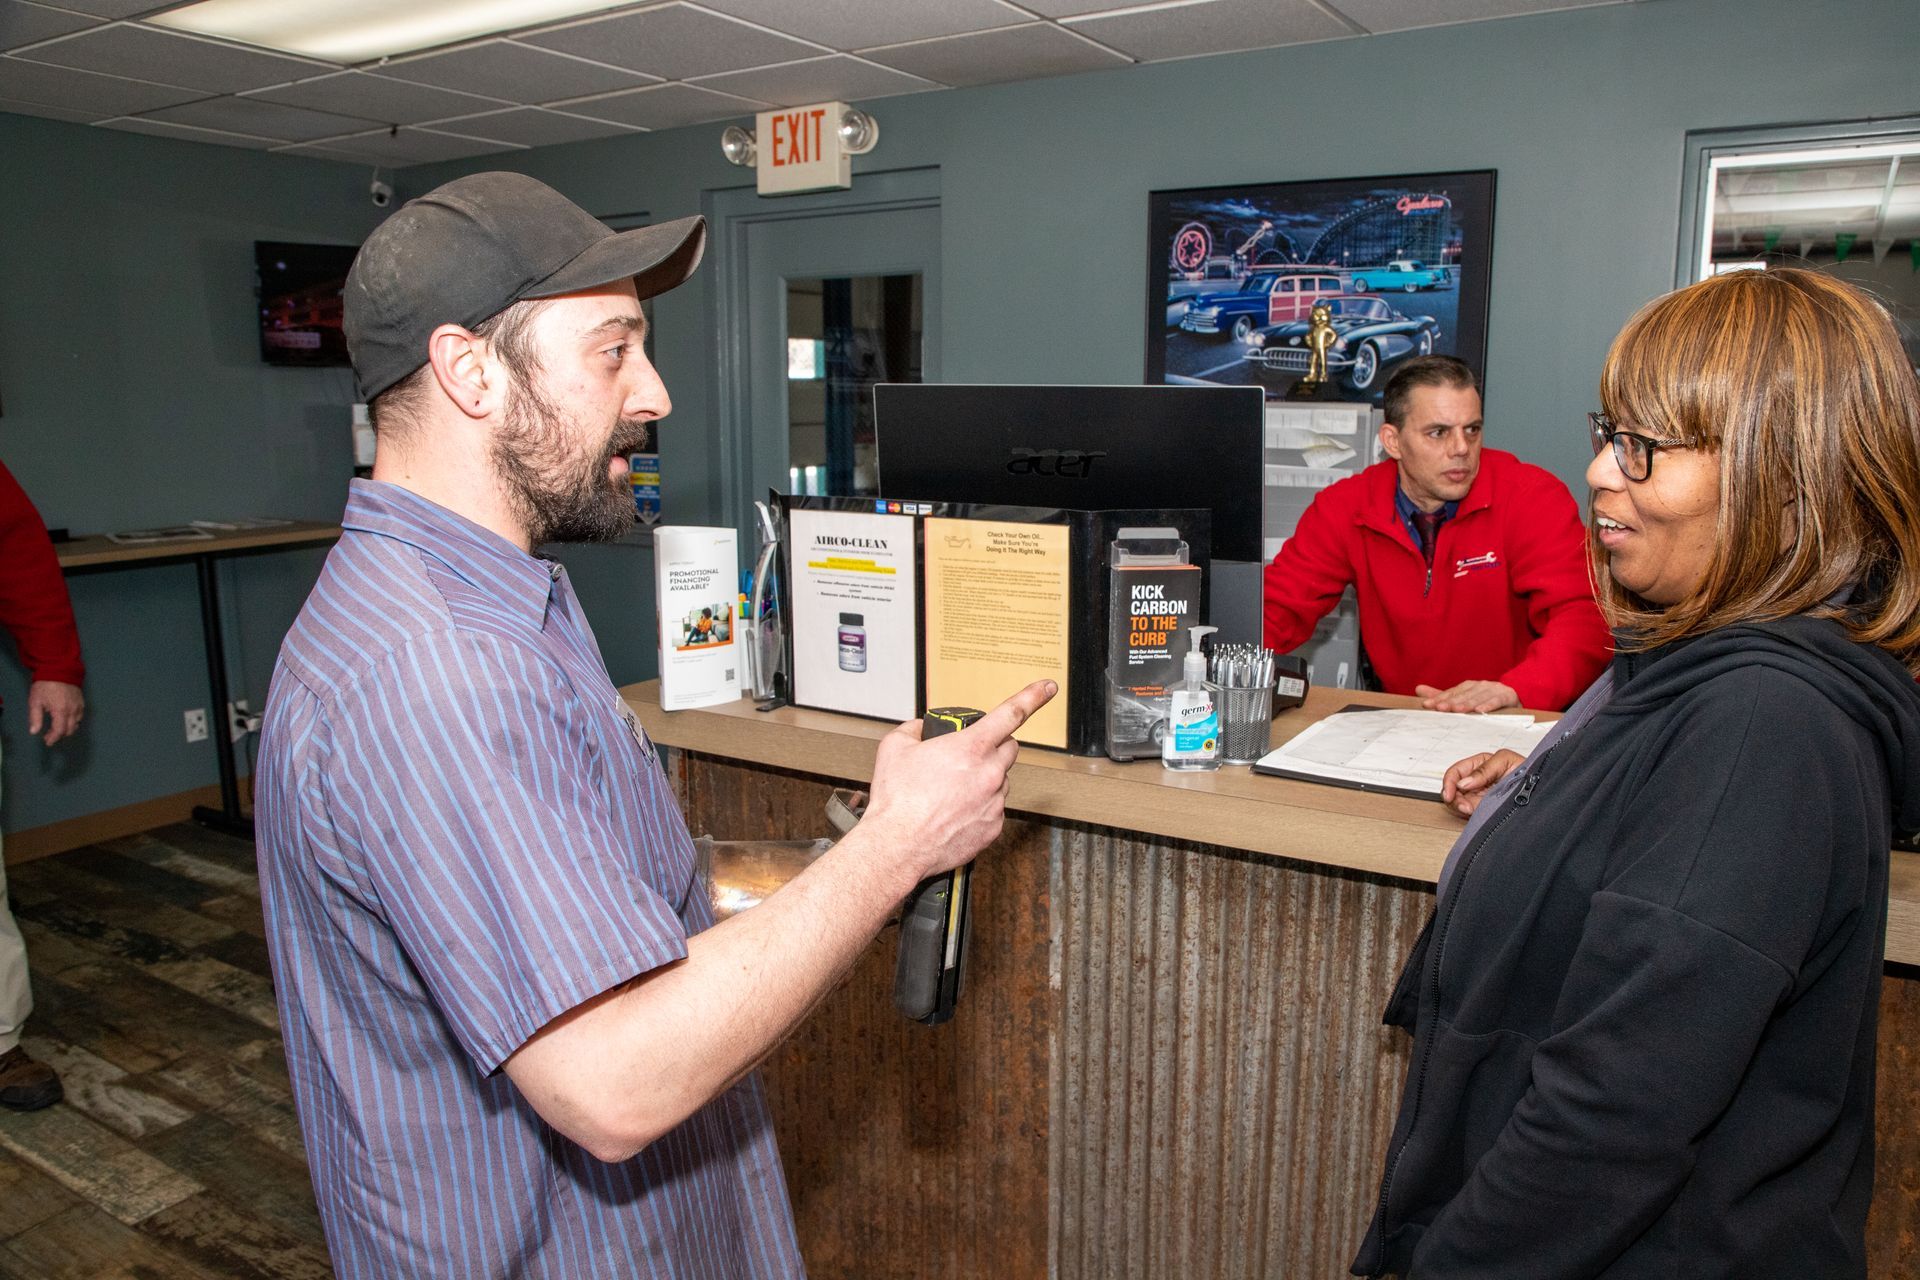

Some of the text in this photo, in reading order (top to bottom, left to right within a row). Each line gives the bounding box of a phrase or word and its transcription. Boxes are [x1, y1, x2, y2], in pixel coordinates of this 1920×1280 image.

[772, 109, 825, 166] EXIT
[1007, 448, 1107, 478] acer
[815, 535, 888, 549] AIRCO-CLEAN
[986, 546, 1001, 554] Doing
[670, 568, 719, 577] PROMOTIONAL
[670, 576, 710, 584] FINANCING
[1132, 585, 1164, 599] KICK
[1131, 600, 1187, 615] CARBON
[1131, 616, 1177, 630] TO THE
[1130, 632, 1167, 646] CURB
[1182, 702, 1213, 716] germ-X
